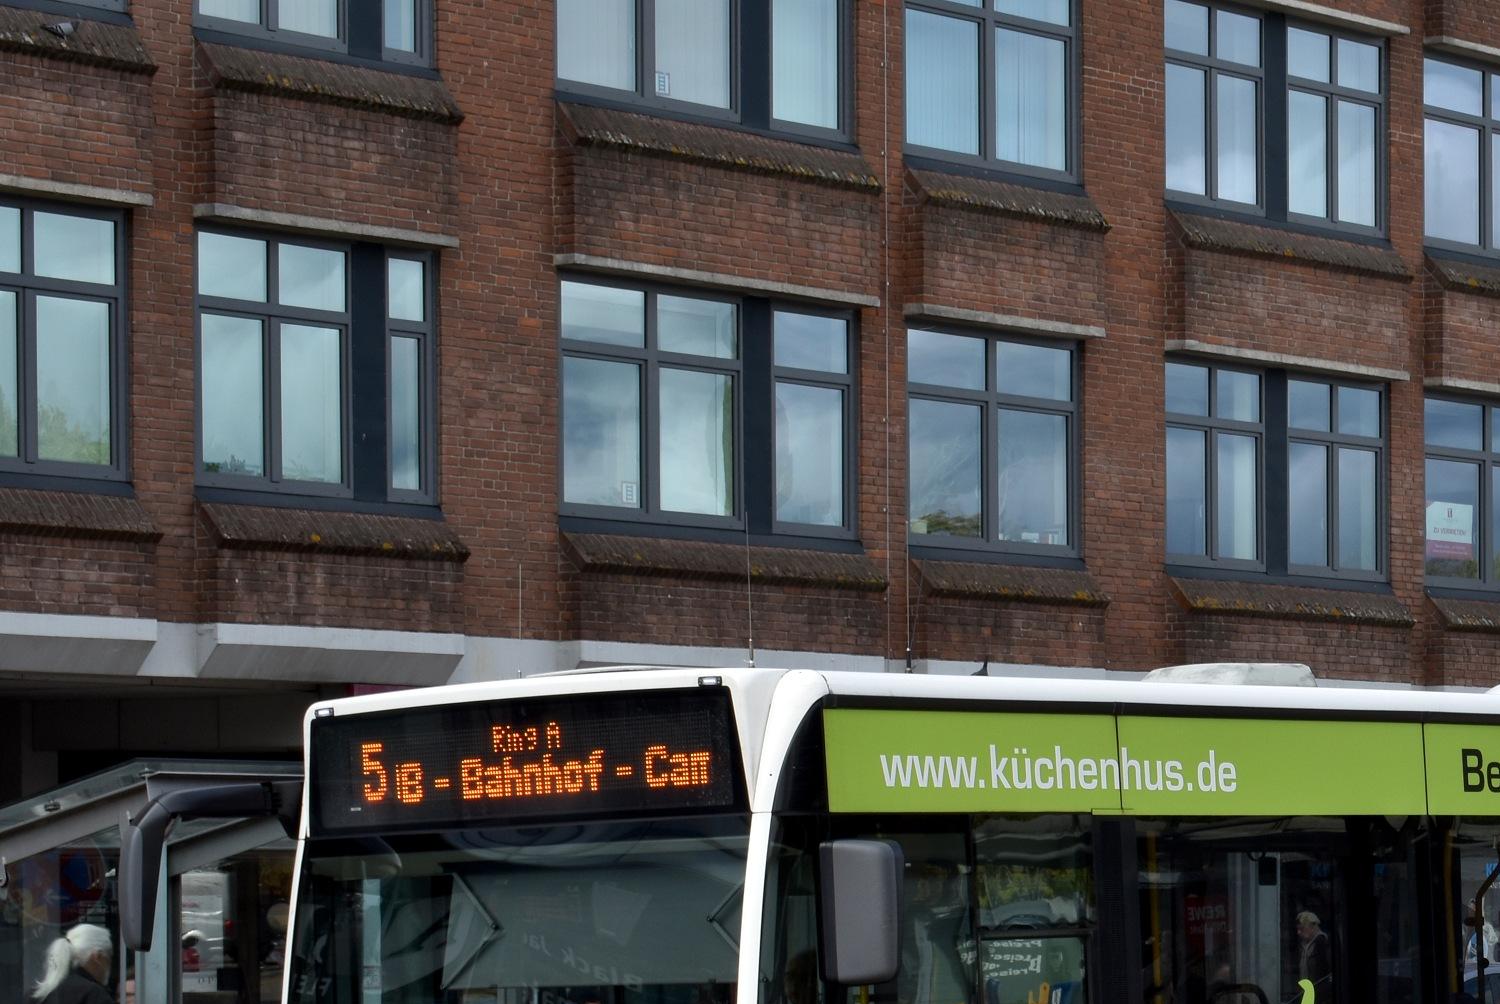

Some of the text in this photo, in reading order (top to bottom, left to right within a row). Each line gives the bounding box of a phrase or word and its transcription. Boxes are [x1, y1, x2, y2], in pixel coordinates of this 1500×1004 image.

[492, 721, 561, 753] Ring A
[362, 742, 388, 801] 5
[461, 747, 604, 801] Bahnhof
[880, 744, 1238, 793] www.küchenhus.de
